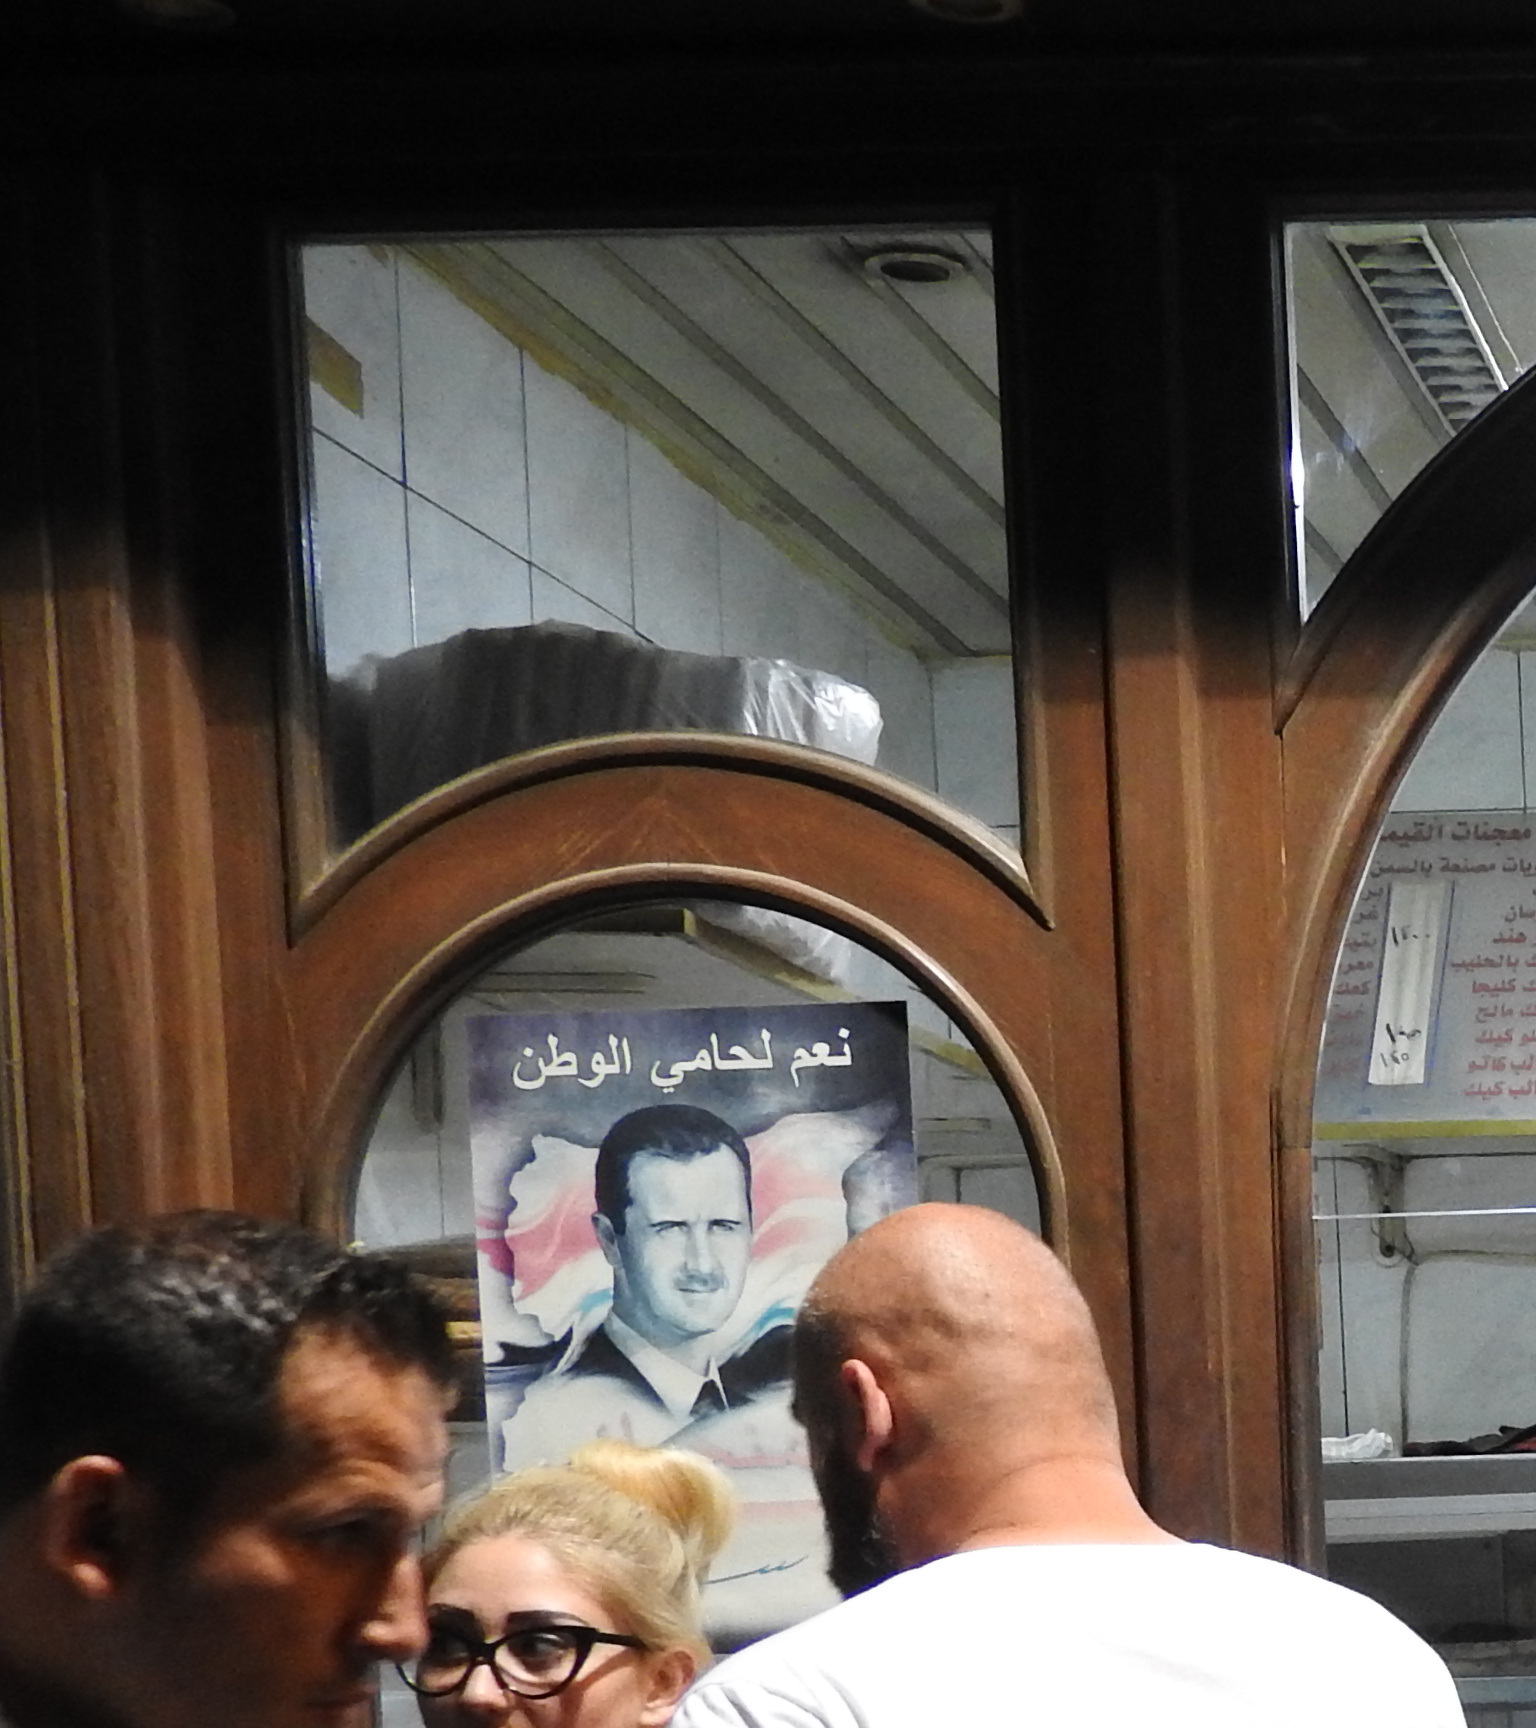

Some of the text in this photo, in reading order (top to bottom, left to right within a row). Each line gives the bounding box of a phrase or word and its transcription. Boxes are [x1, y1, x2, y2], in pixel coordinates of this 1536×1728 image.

[511, 1026, 853, 1093] نعم لحامي الوطن
